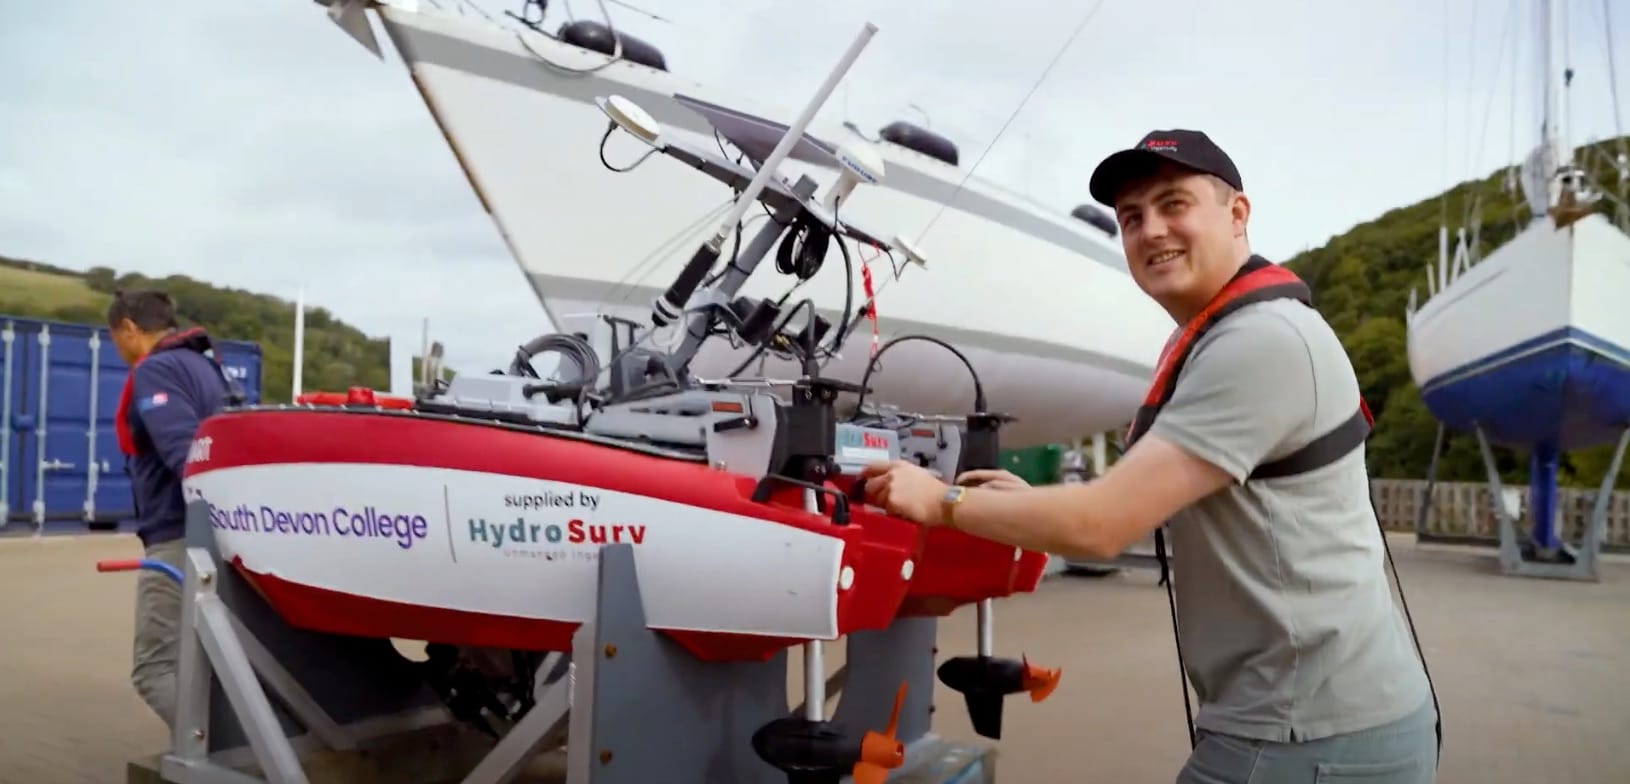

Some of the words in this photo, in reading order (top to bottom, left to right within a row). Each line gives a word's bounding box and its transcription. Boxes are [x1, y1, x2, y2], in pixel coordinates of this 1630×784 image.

[504, 490, 574, 511] supplied
[579, 491, 599, 511] by
[208, 503, 258, 532] South
[260, 506, 330, 536] Devon
[332, 506, 428, 550] College
[468, 517, 646, 548] HydroSurv
